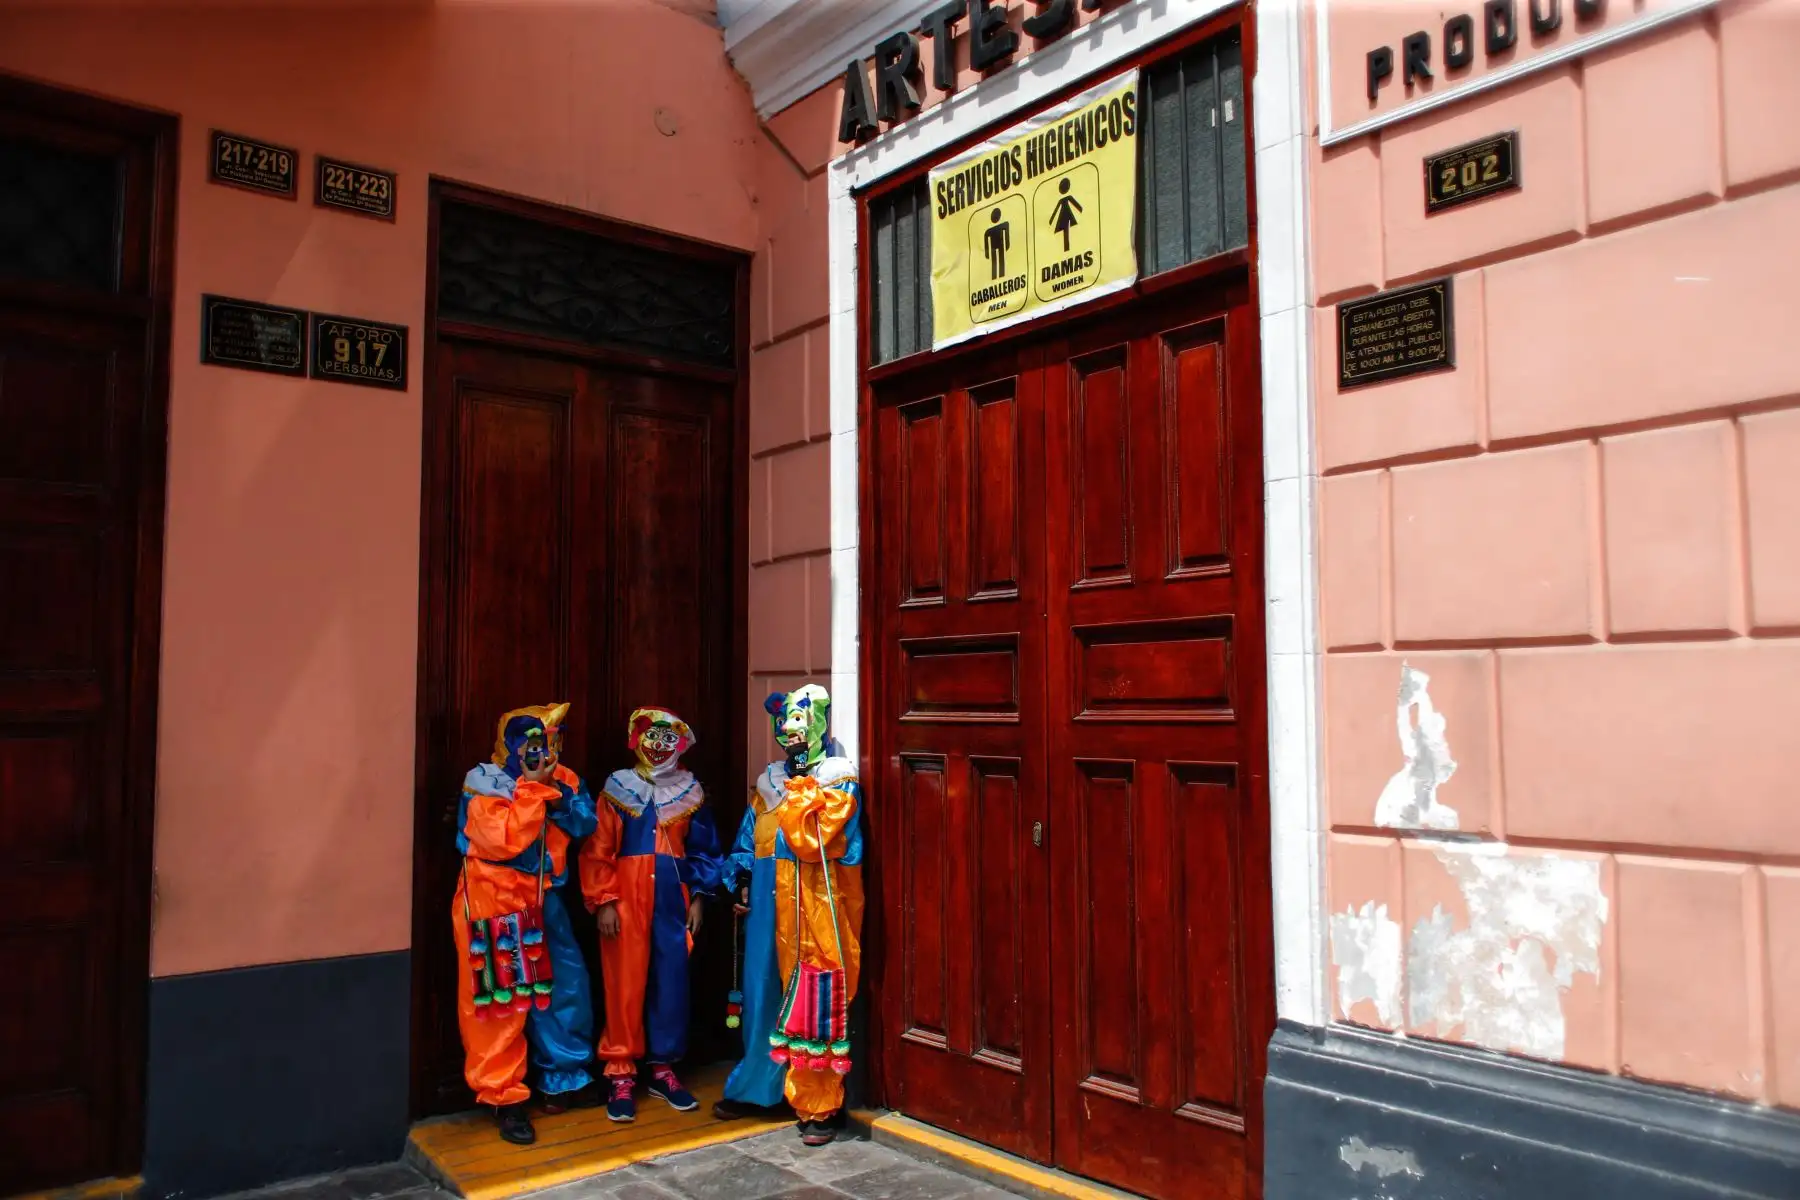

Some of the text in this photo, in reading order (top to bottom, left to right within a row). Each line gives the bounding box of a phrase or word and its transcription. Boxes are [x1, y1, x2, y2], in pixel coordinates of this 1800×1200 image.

[1366, 0, 1599, 101] PRODU
[838, 0, 1101, 144] ARTE
[221, 140, 289, 176] 217-219
[937, 91, 1136, 220] SERVICIOS HIGIENICOS
[325, 167, 388, 200] 221-223
[1441, 154, 1498, 193] 202
[1041, 250, 1094, 284] DAMAS
[971, 274, 1027, 307] CABALLEROS
[1052, 275, 1085, 293] WOMEN
[988, 300, 1007, 313] MEN
[1353, 297, 1431, 323] ESTA PUERTA DEBE
[328, 325, 393, 344] AFORO
[1350, 308, 1436, 335] PERMANECER ABIERTA
[1352, 321, 1434, 346] DURANTE LAS HORAS
[334, 337, 388, 367] 917
[1345, 350, 1357, 360] DE
[1358, 342, 1395, 357] ATENCION
[1408, 331, 1442, 345] PUBLICO
[325, 360, 395, 379] PERSONAS
[1346, 362, 1357, 372] DE
